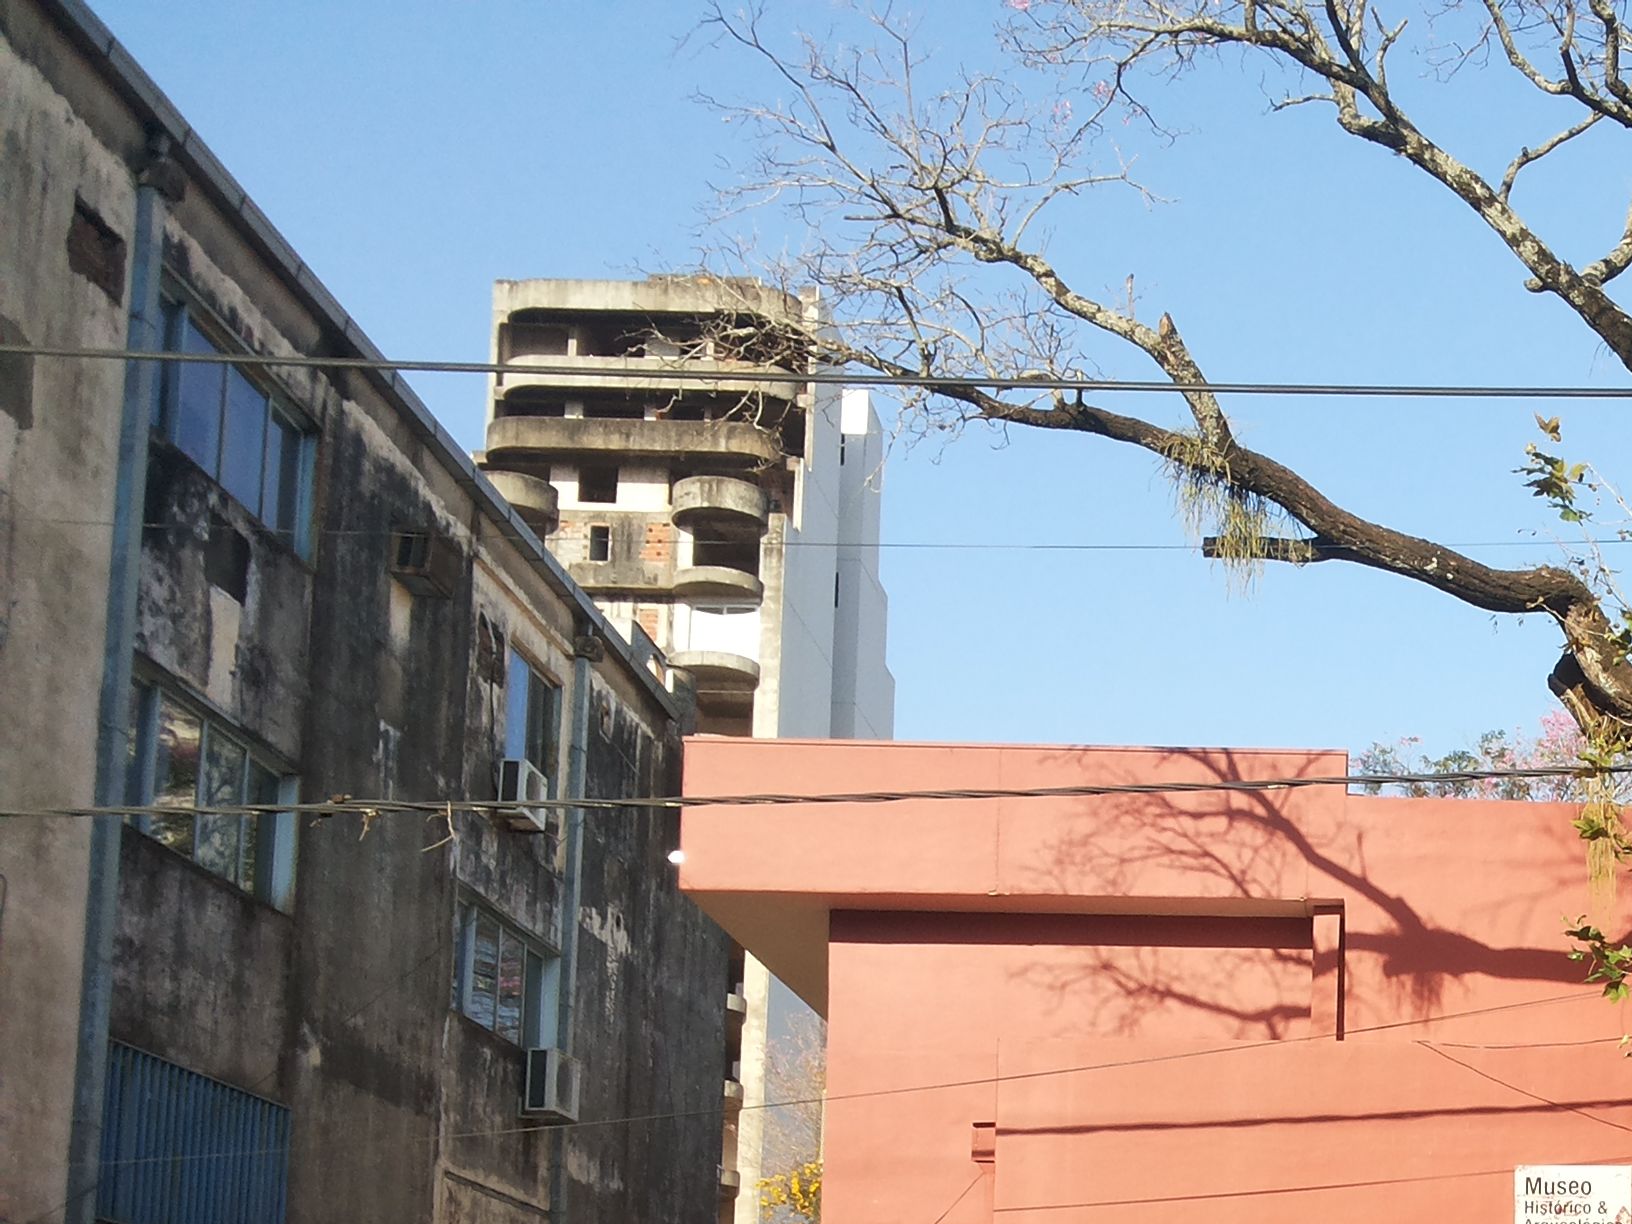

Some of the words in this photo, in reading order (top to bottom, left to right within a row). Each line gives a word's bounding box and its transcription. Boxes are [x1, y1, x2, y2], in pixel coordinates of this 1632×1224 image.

[1525, 1176, 1592, 1196] Museo
[1524, 1199, 1592, 1215] Histórico
[1597, 1200, 1608, 1215] &
